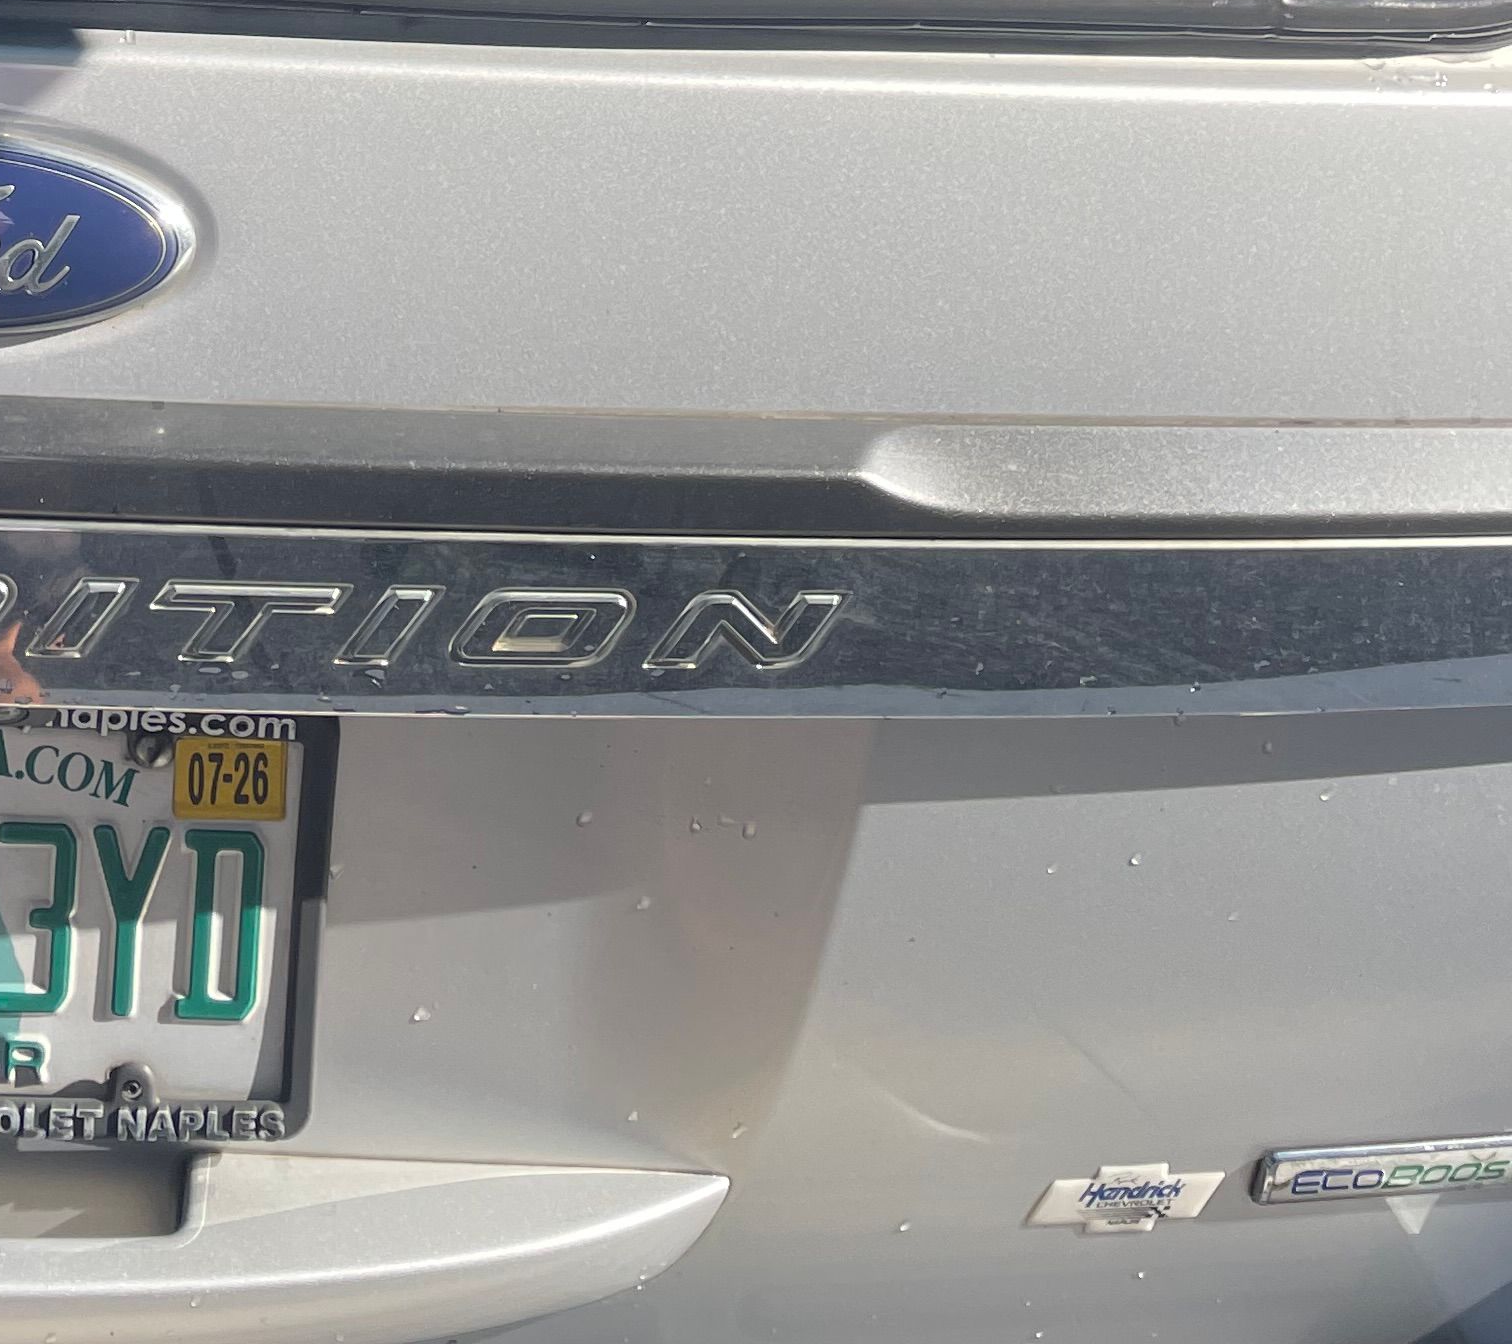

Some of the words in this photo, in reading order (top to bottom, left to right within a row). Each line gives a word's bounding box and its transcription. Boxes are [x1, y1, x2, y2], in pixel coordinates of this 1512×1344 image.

[189, 752, 269, 806] 07-26
[117, 1105, 287, 1144] NAPLES
[1079, 1179, 1186, 1208] Hendrick
[1291, 1160, 1512, 1195] ECOBOOS
